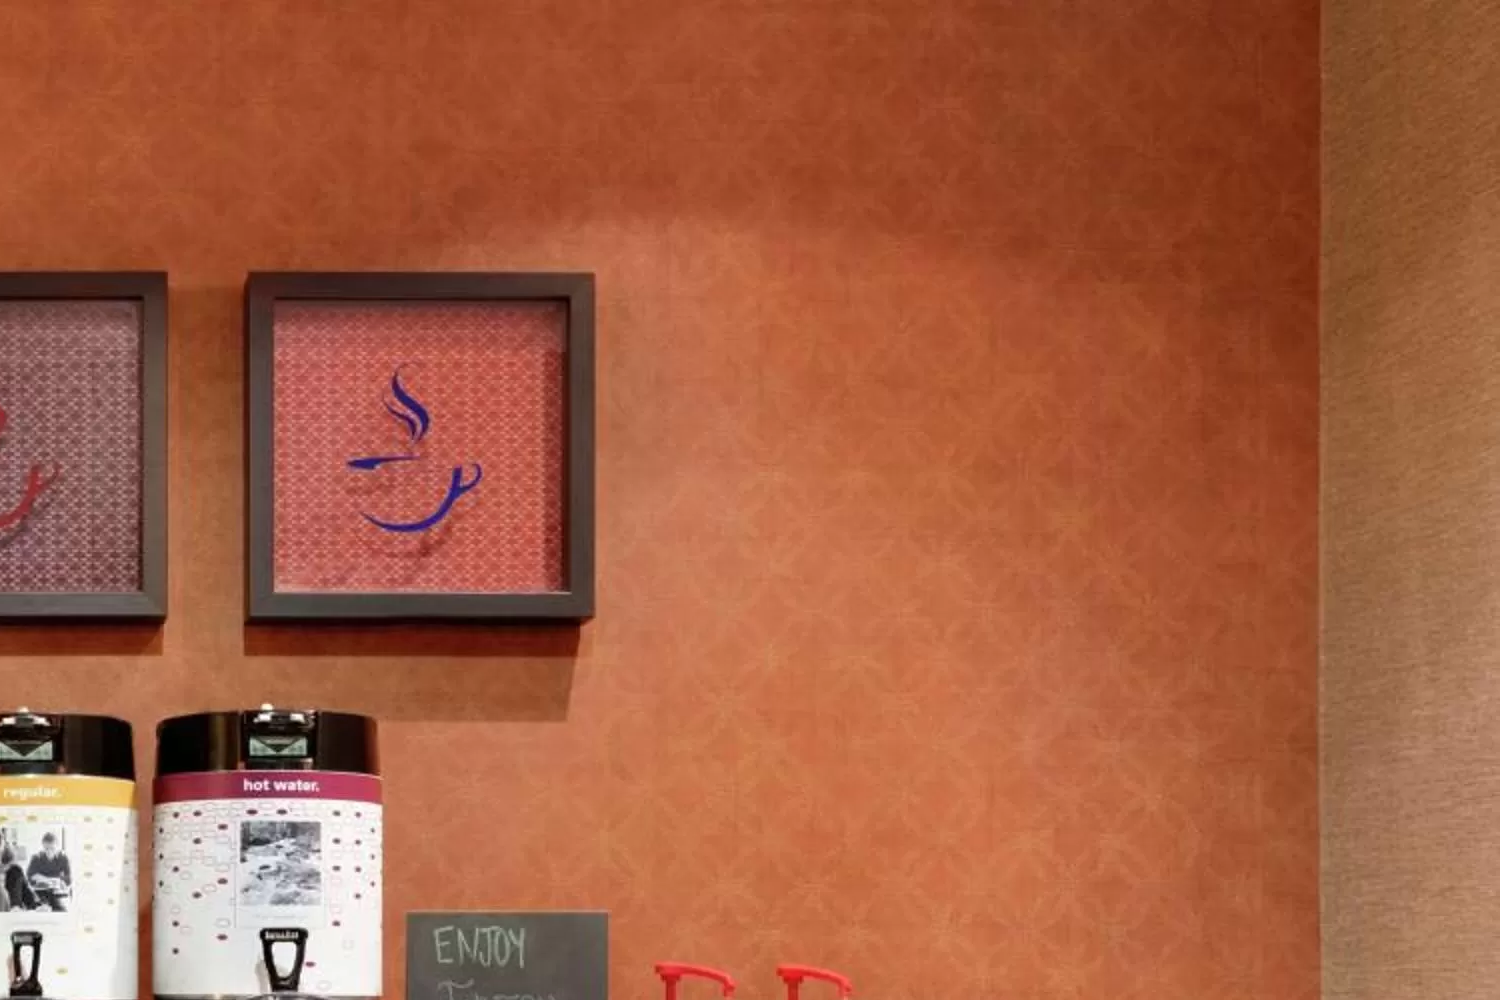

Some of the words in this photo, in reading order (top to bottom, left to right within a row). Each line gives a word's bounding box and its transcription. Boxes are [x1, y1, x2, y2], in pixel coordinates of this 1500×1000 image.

[243, 777, 270, 792] hot
[273, 778, 321, 792] water.
[3, 785, 62, 801] regular.
[433, 925, 526, 968] ENJOY
